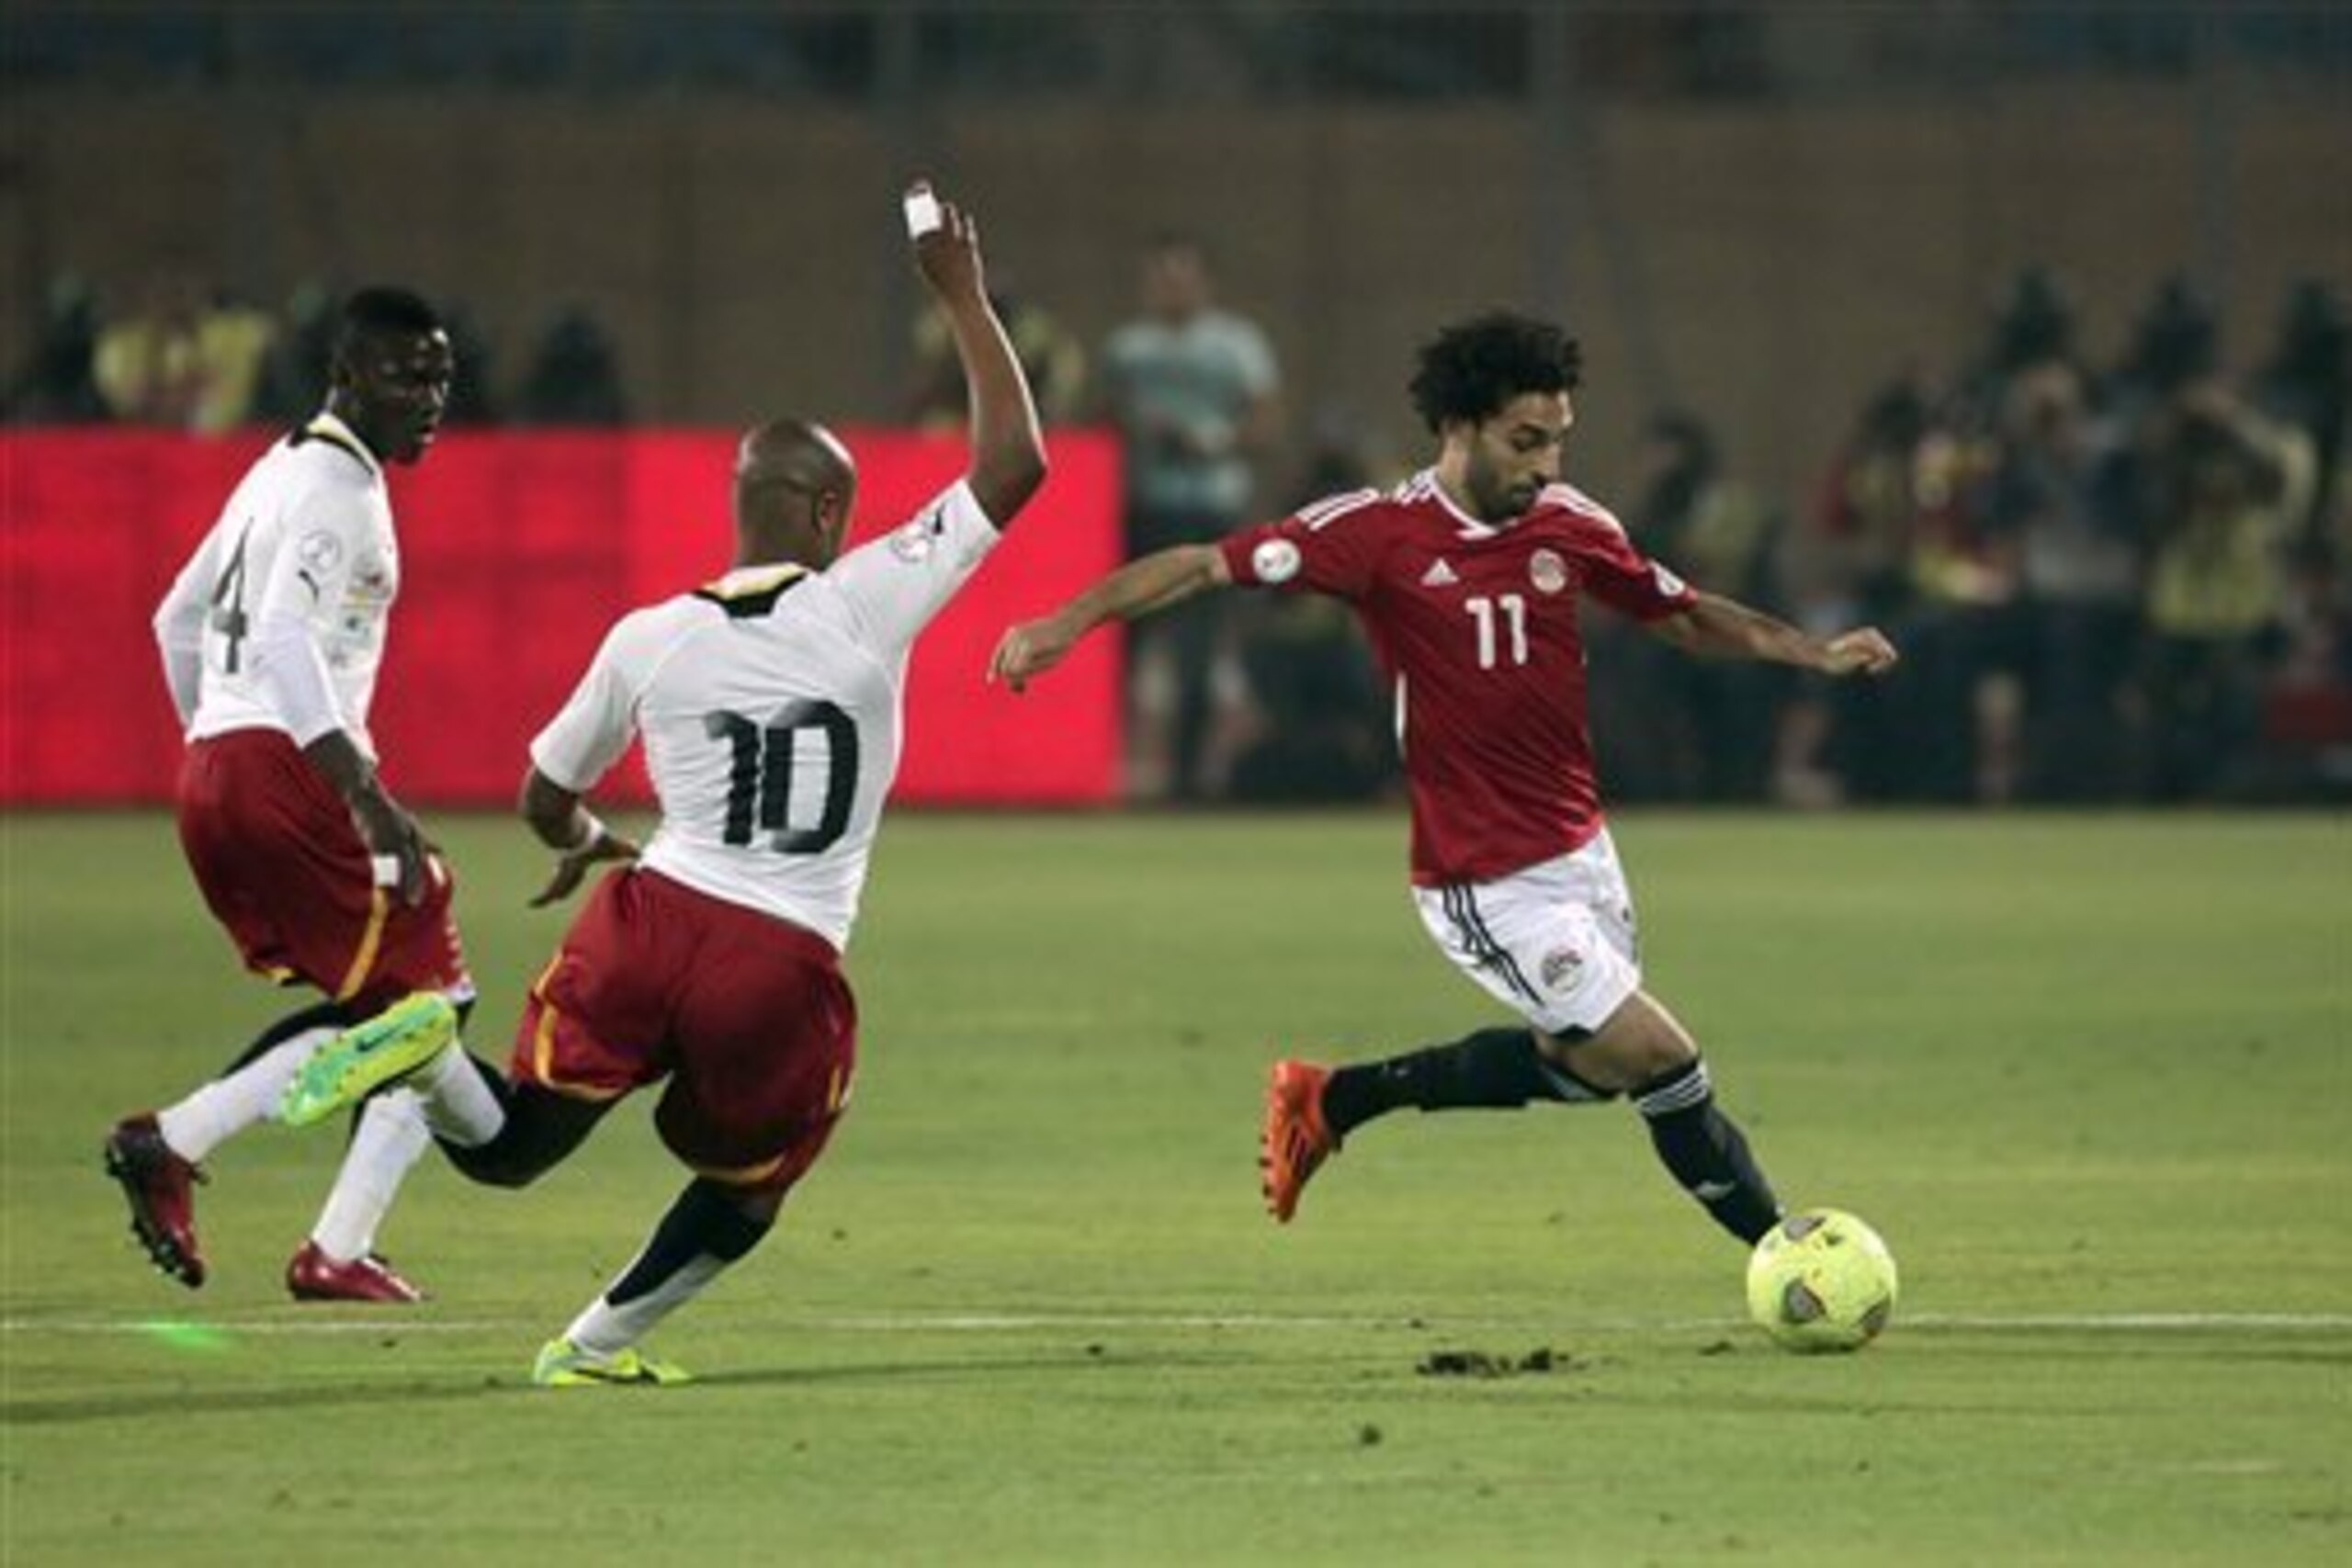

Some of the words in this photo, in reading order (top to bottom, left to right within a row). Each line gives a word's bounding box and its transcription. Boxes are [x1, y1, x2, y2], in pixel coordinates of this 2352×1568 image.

[210, 516, 247, 673] 4
[1465, 594, 1527, 669] 11
[704, 700, 858, 852] 10
